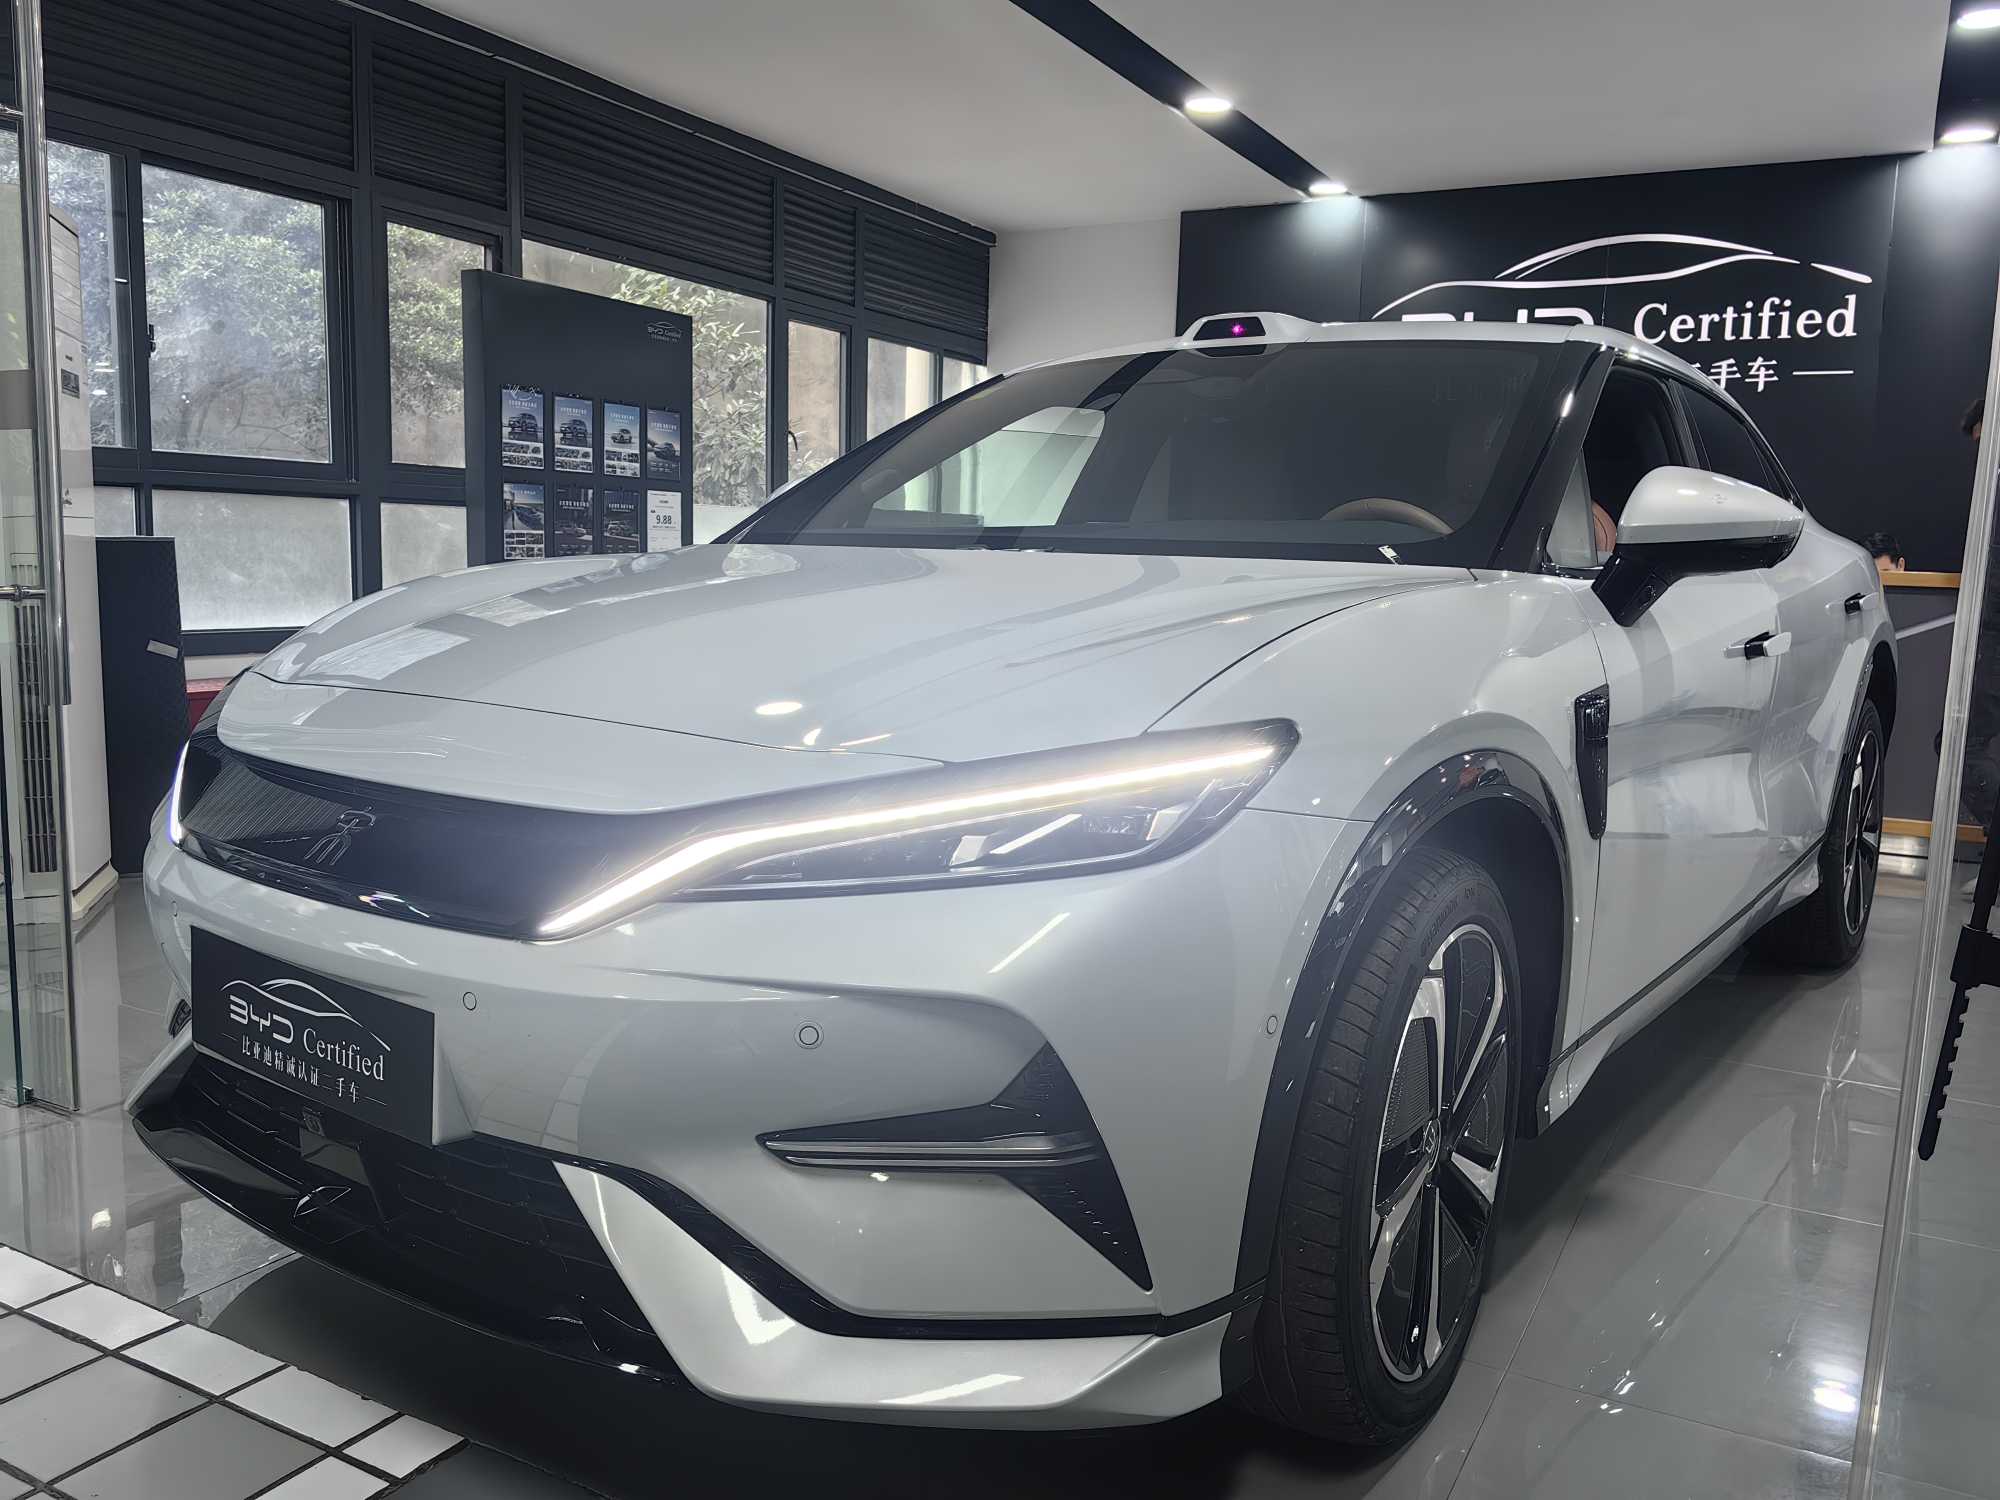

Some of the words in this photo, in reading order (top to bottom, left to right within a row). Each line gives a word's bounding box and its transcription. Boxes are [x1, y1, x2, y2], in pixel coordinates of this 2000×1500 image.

[1634, 294, 1857, 344] Certified
[1691, 356, 1779, 392] 手车
[656, 514, 672, 525] 9.88
[230, 995, 294, 1043] BYD
[303, 1028, 384, 1081] Certified
[242, 1034, 360, 1103] 比亚迪精诚认证二手车
